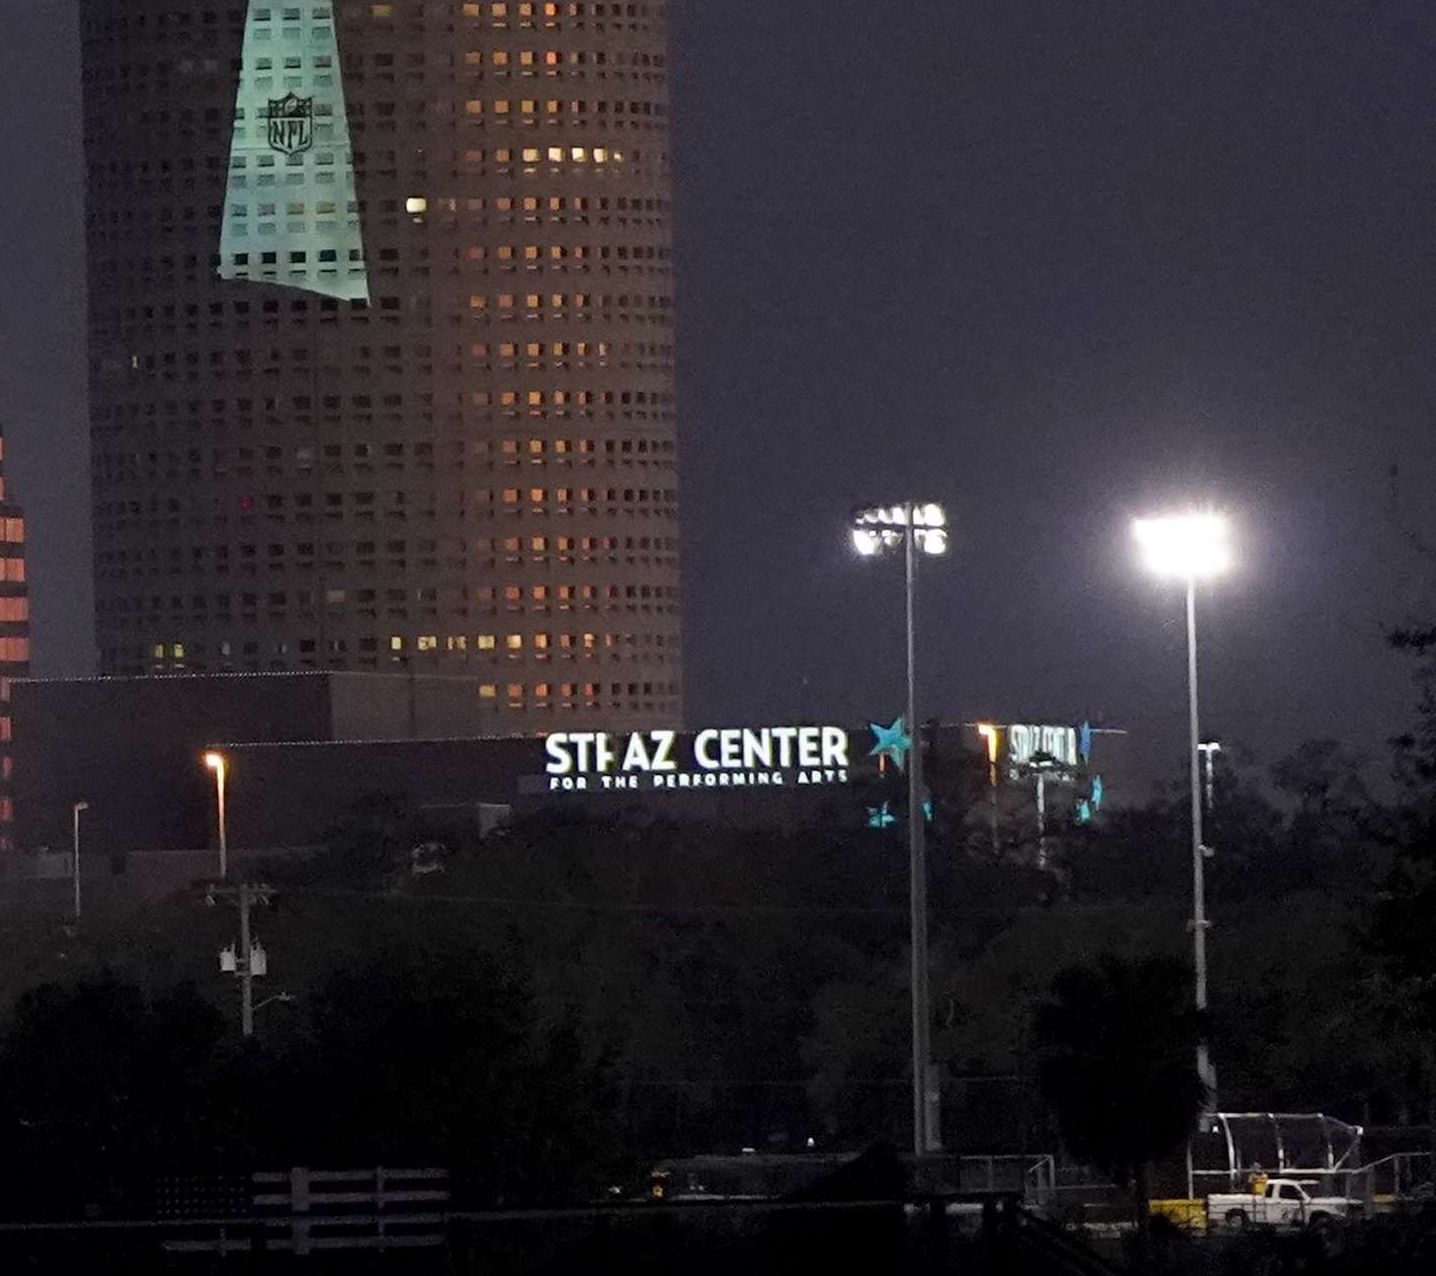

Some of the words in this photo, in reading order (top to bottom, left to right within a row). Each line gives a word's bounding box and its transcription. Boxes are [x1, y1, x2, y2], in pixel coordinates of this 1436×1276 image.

[273, 120, 309, 150] NFL
[693, 726, 849, 769] CENTER
[549, 776, 587, 791] FOR
[601, 774, 639, 789] THE
[653, 771, 784, 788] PERFORMING
[797, 769, 848, 784] ARTS
